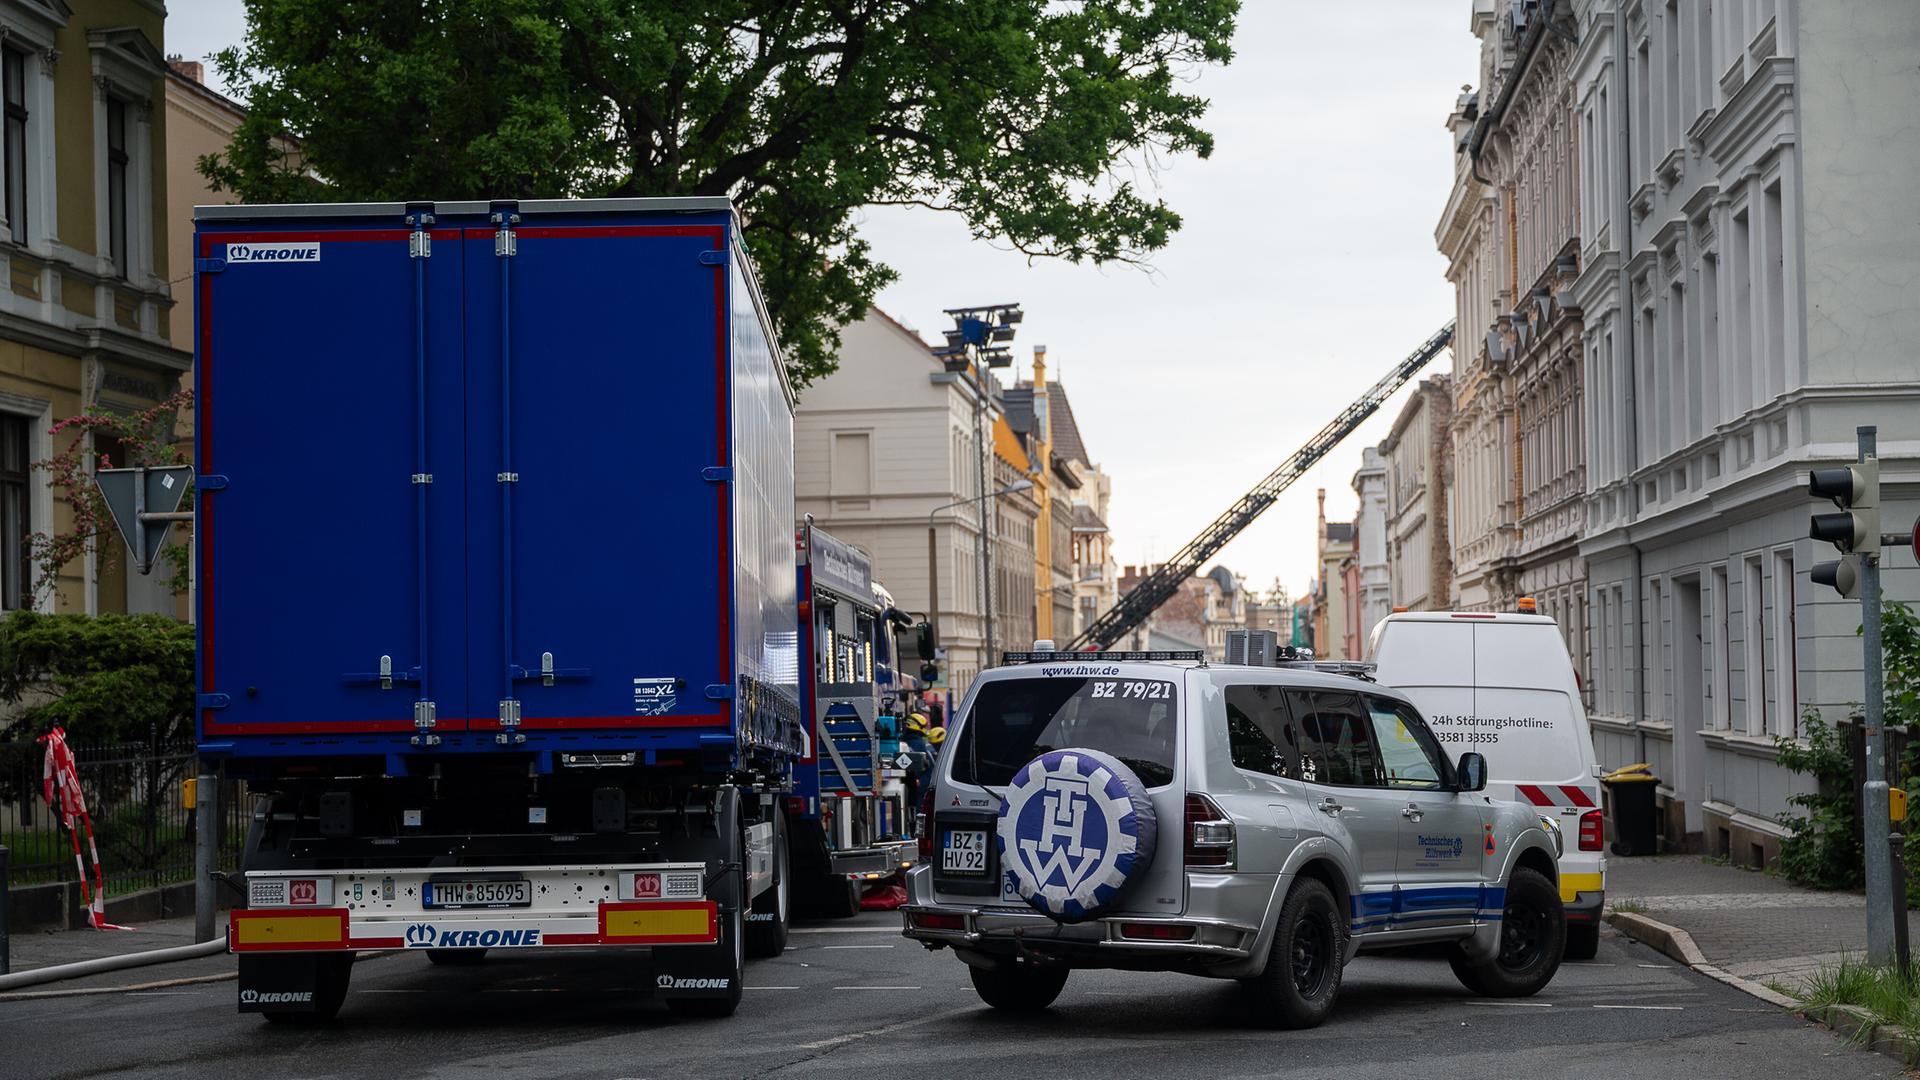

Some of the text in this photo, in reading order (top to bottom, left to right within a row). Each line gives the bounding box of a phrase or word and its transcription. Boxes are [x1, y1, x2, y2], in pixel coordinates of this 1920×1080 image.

[251, 249, 317, 260] KRONE
[1041, 666, 1120, 676] www.thw.de
[655, 684, 674, 697] XL
[1091, 682, 1171, 700] BZ 79/21
[1432, 715, 1553, 729] 24h Störungshotline:
[1467, 733, 1499, 743] 33555
[953, 833, 972, 849] BZ
[1020, 777, 1101, 893] THW
[945, 851, 983, 868] HV 92
[434, 884, 524, 902] THW 85695
[439, 930, 540, 947] KRONE
[674, 979, 729, 988] KRONE
[259, 992, 312, 1003] KRONE
